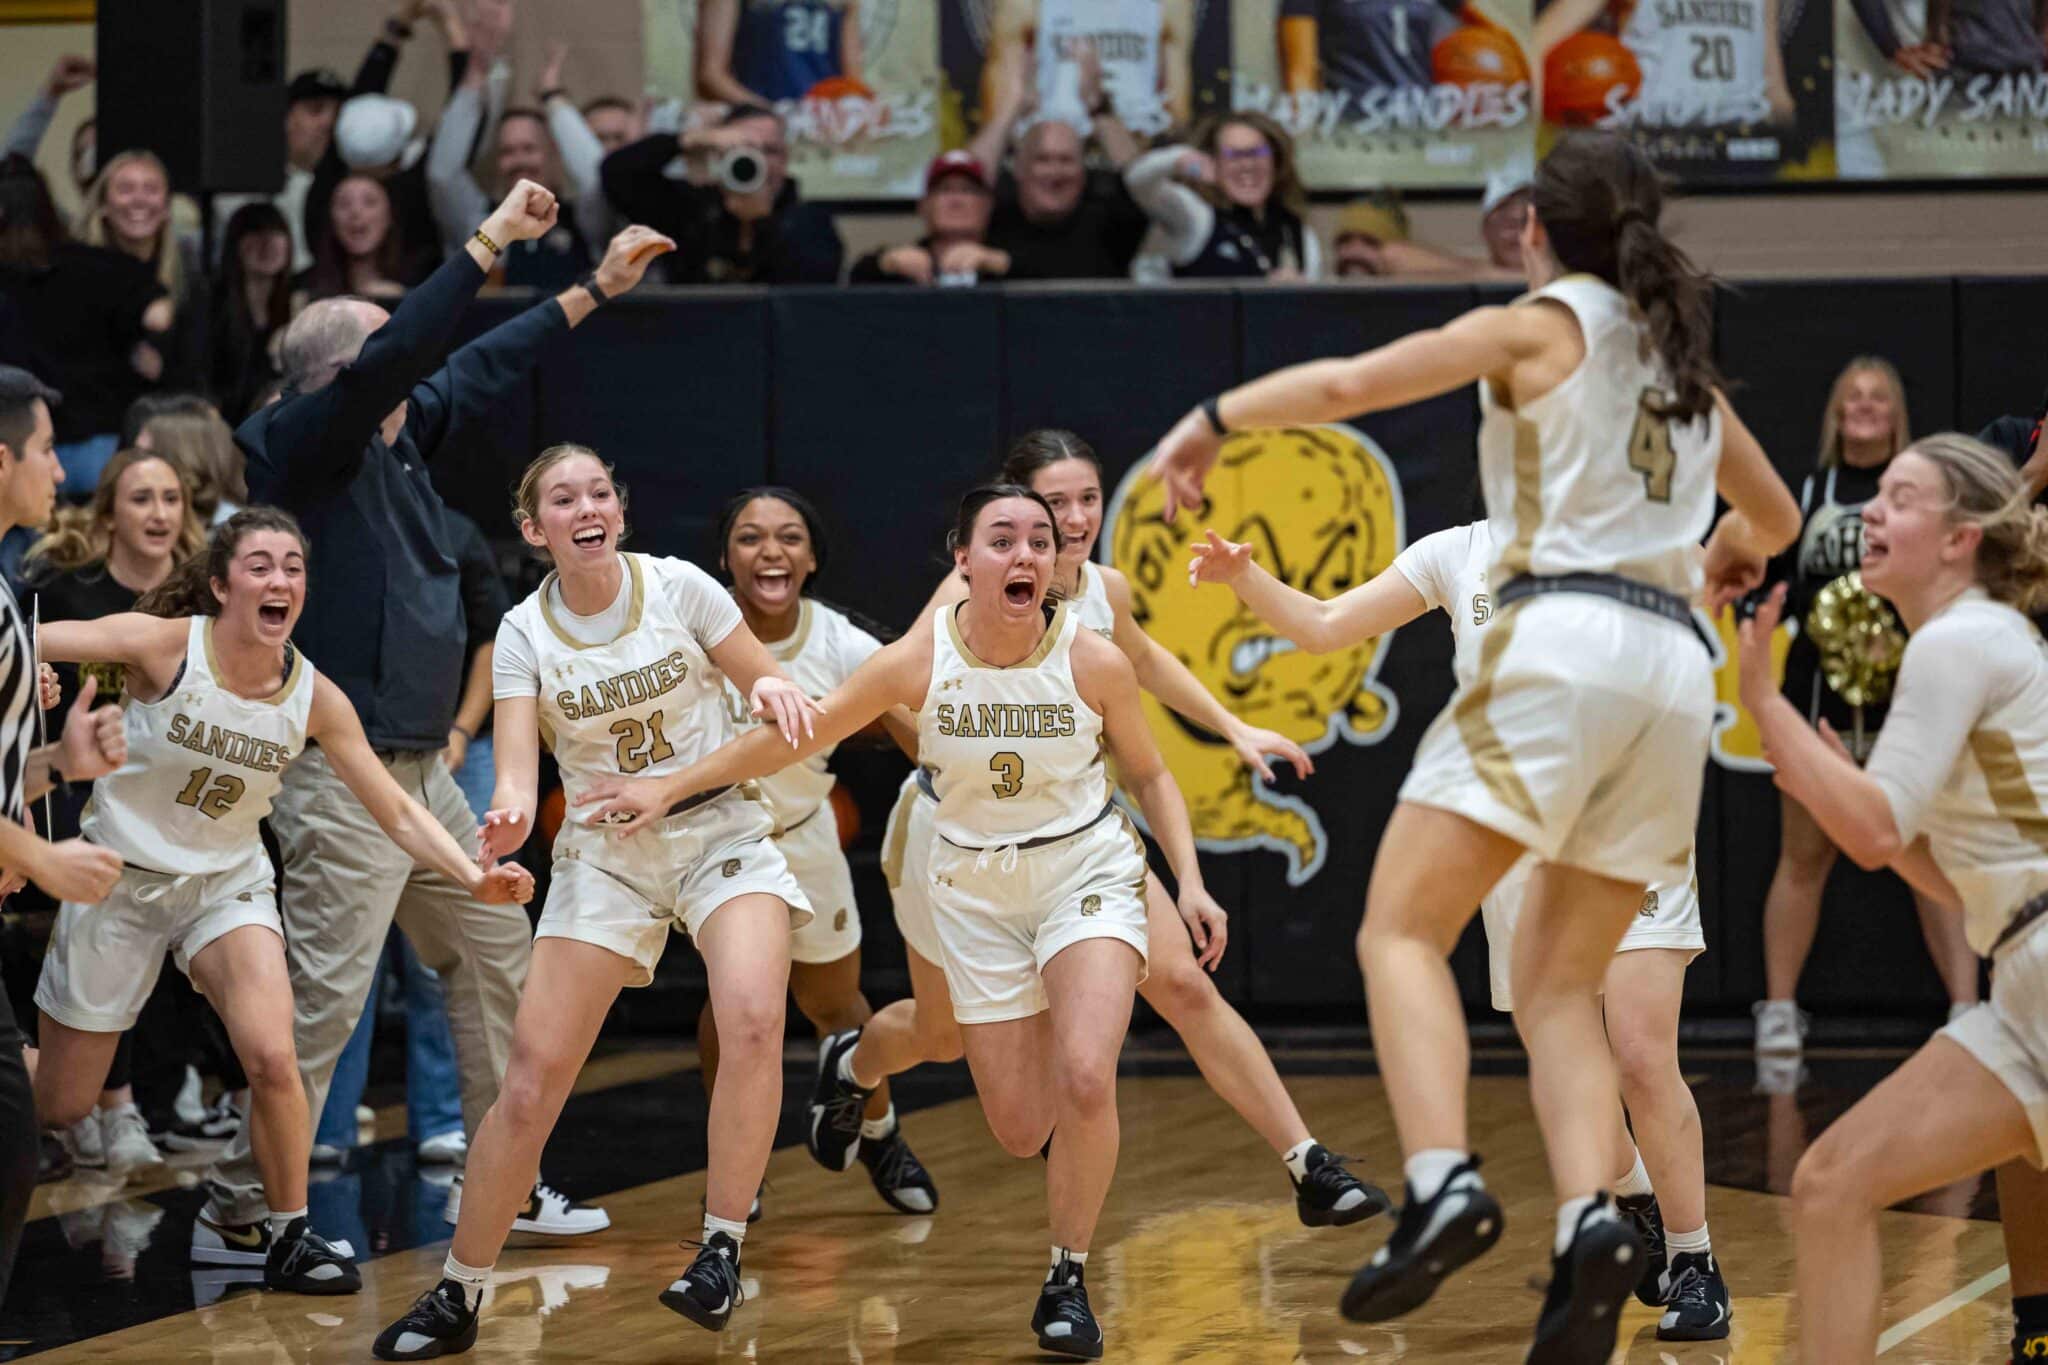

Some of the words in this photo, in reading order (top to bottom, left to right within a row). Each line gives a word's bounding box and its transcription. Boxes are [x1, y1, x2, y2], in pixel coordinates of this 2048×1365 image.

[1688, 34, 1736, 81] 20
[1353, 80, 1529, 135] SANDIES
[1851, 72, 1953, 129] LADY
[1626, 386, 1677, 505] 4
[557, 650, 689, 721] SANDIES
[166, 712, 291, 774] SANDIES
[608, 709, 676, 774] 21
[938, 703, 1077, 738] SANDIES
[175, 766, 247, 821] 12
[989, 750, 1025, 800] 3
